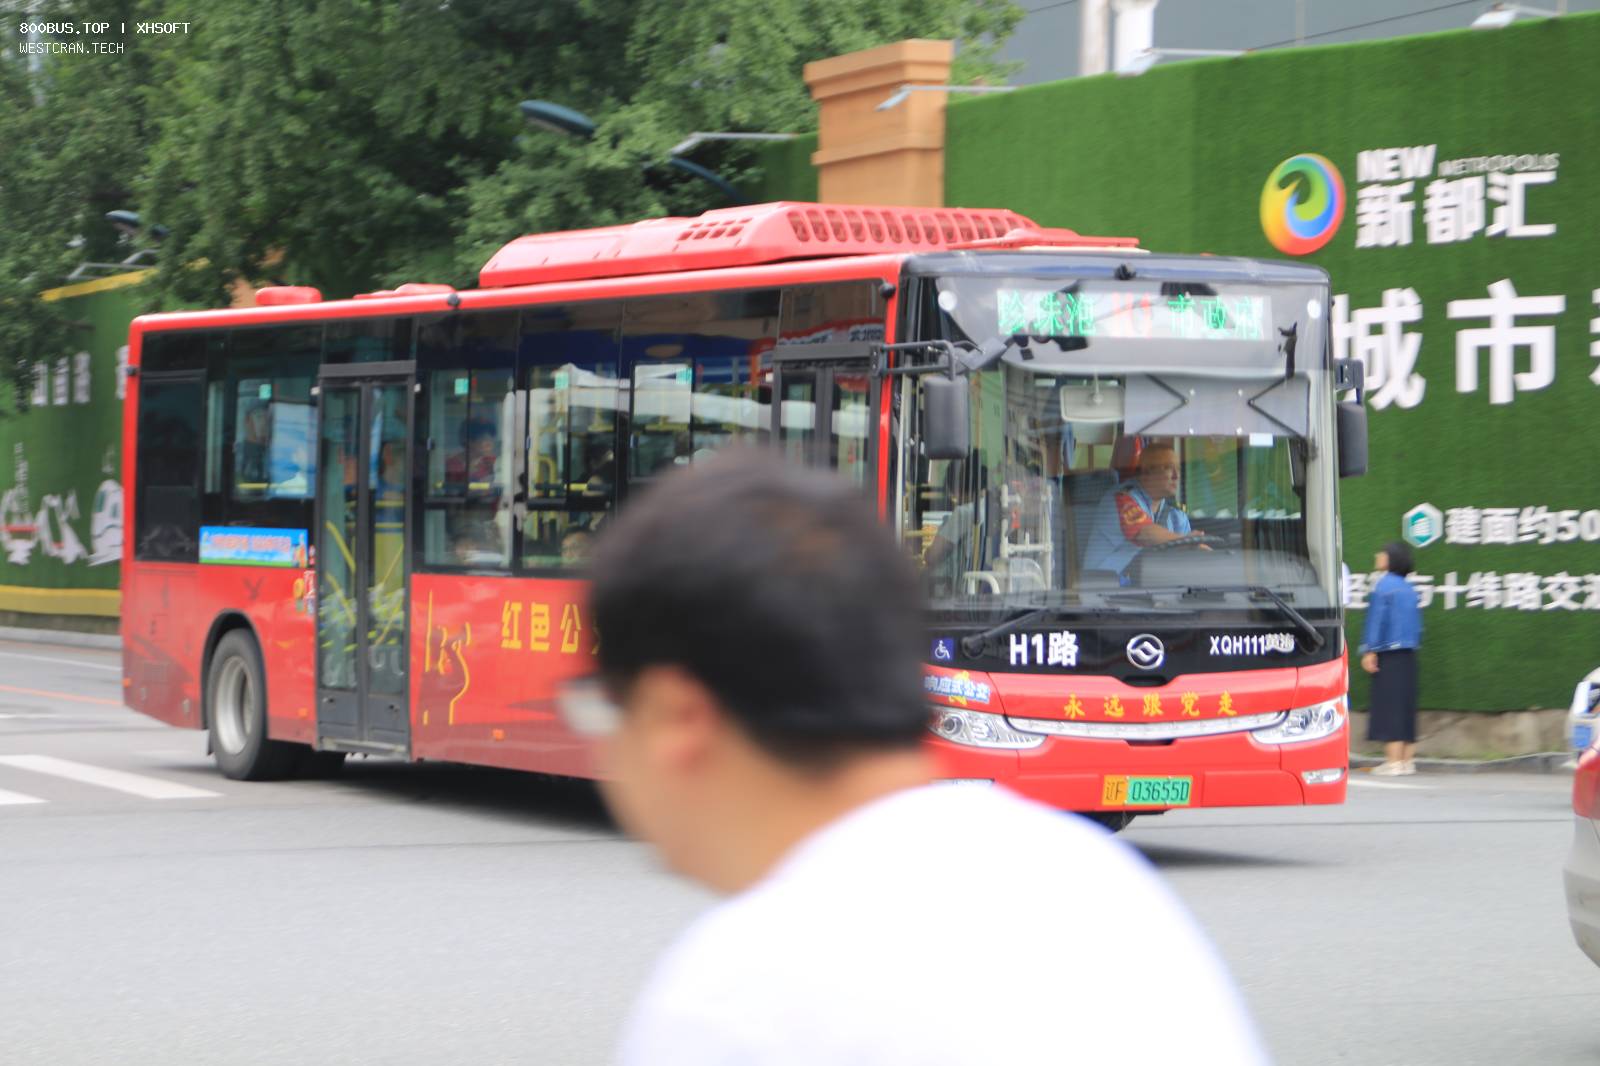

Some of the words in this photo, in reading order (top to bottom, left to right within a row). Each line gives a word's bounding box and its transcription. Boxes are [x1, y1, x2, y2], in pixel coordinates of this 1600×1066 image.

[1356, 144, 1437, 183] NEW
[1355, 171, 1557, 248] 新都汇
[1331, 279, 1600, 411] 城市
[501, 600, 600, 655] 红色公
[1209, 634, 1265, 656] XQH111
[1009, 631, 1079, 667] H1路
[1063, 690, 1237, 719] 永远跟党走
